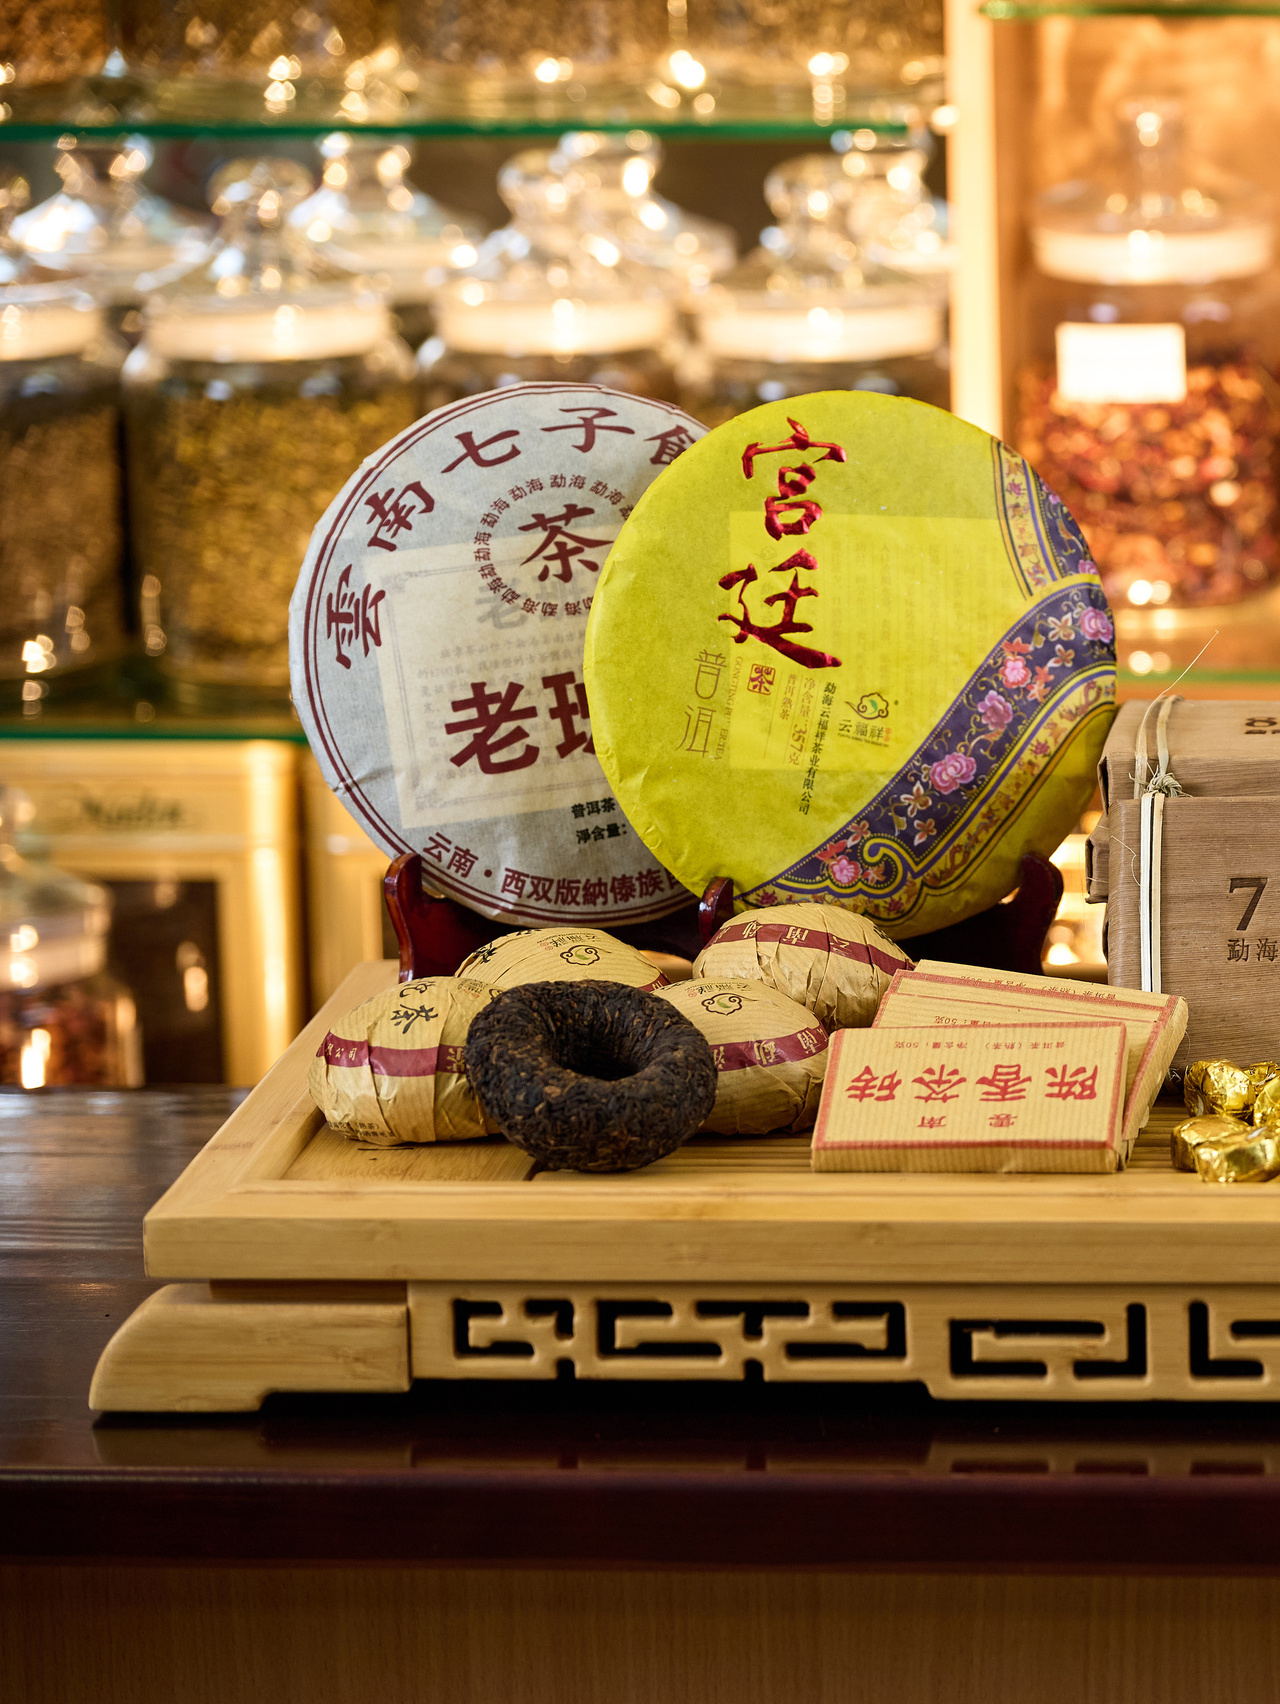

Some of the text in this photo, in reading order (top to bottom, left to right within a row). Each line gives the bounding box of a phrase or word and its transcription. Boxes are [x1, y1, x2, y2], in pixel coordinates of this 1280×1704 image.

[518, 504, 614, 583] 茶
[717, 416, 847, 669] 宫廷
[748, 664, 776, 695] 茶
[571, 797, 616, 819] 普洱茶
[845, 1064, 1098, 1103] 陈香茶砖
